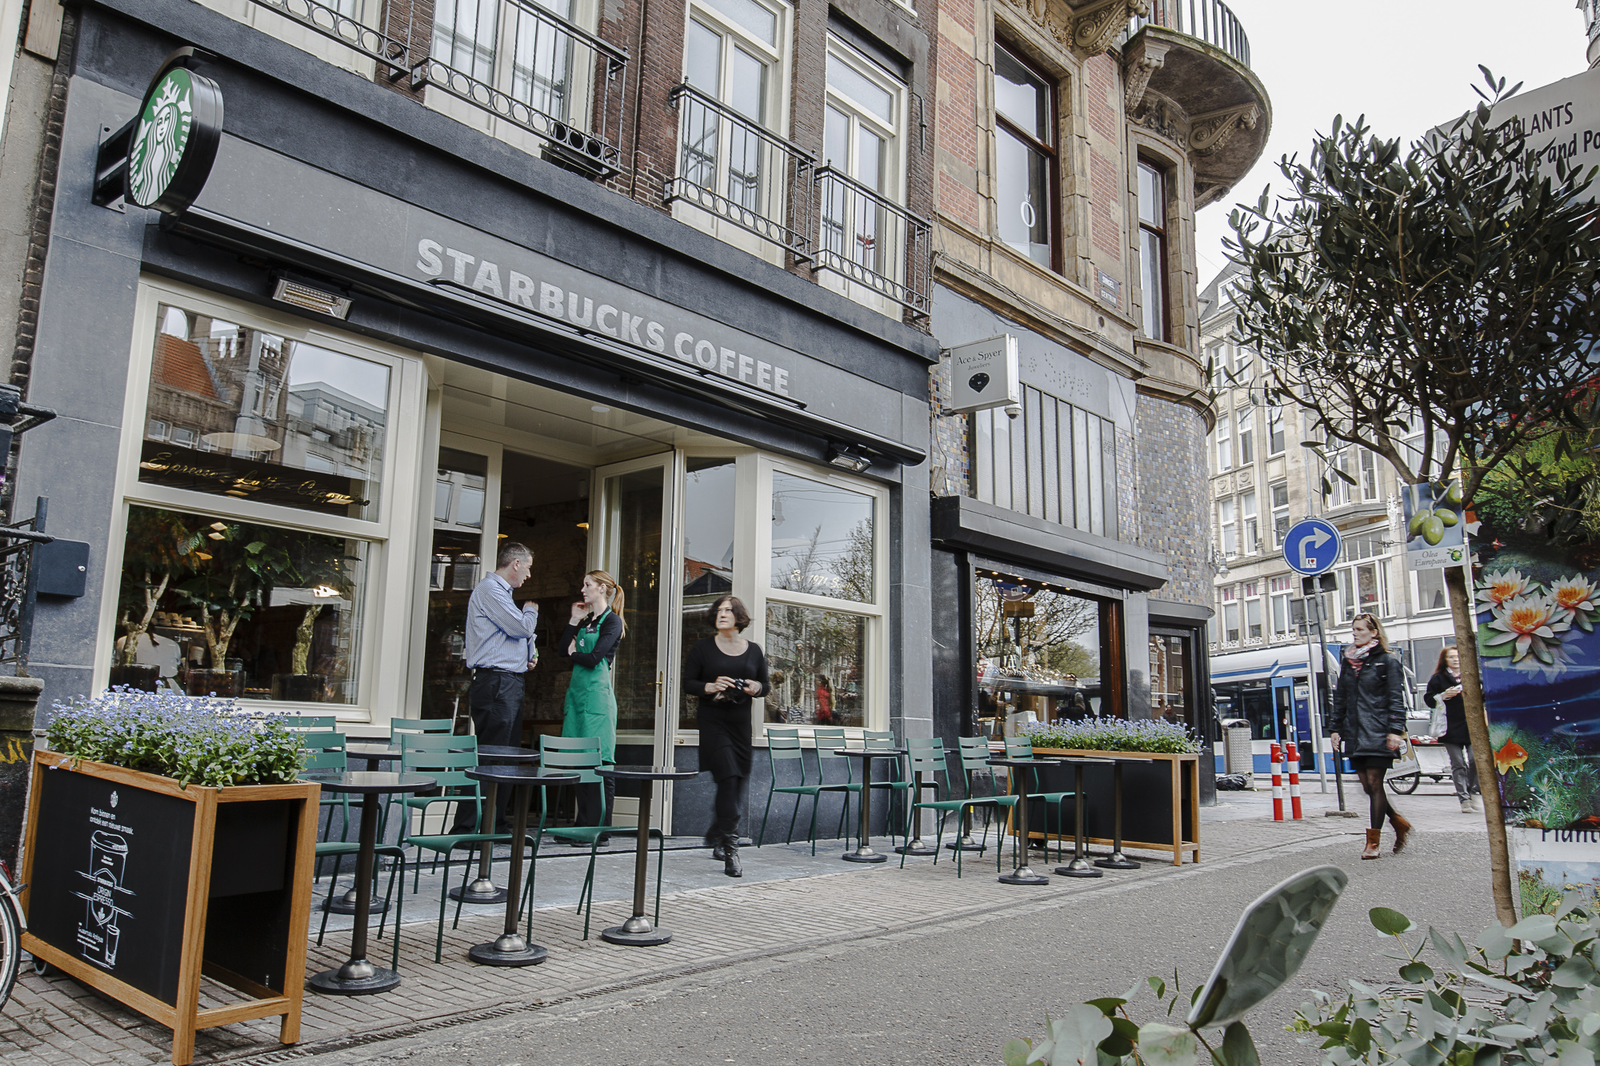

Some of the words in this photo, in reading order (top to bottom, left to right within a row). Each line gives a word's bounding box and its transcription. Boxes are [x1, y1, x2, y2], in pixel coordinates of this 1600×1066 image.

[1547, 132, 1577, 163] and
[416, 238, 665, 353] STARBUCKS
[674, 331, 789, 396] COFFEE
[957, 356, 971, 366] Ace
[977, 350, 1002, 361] Spyer
[1422, 550, 1439, 559] Olea
